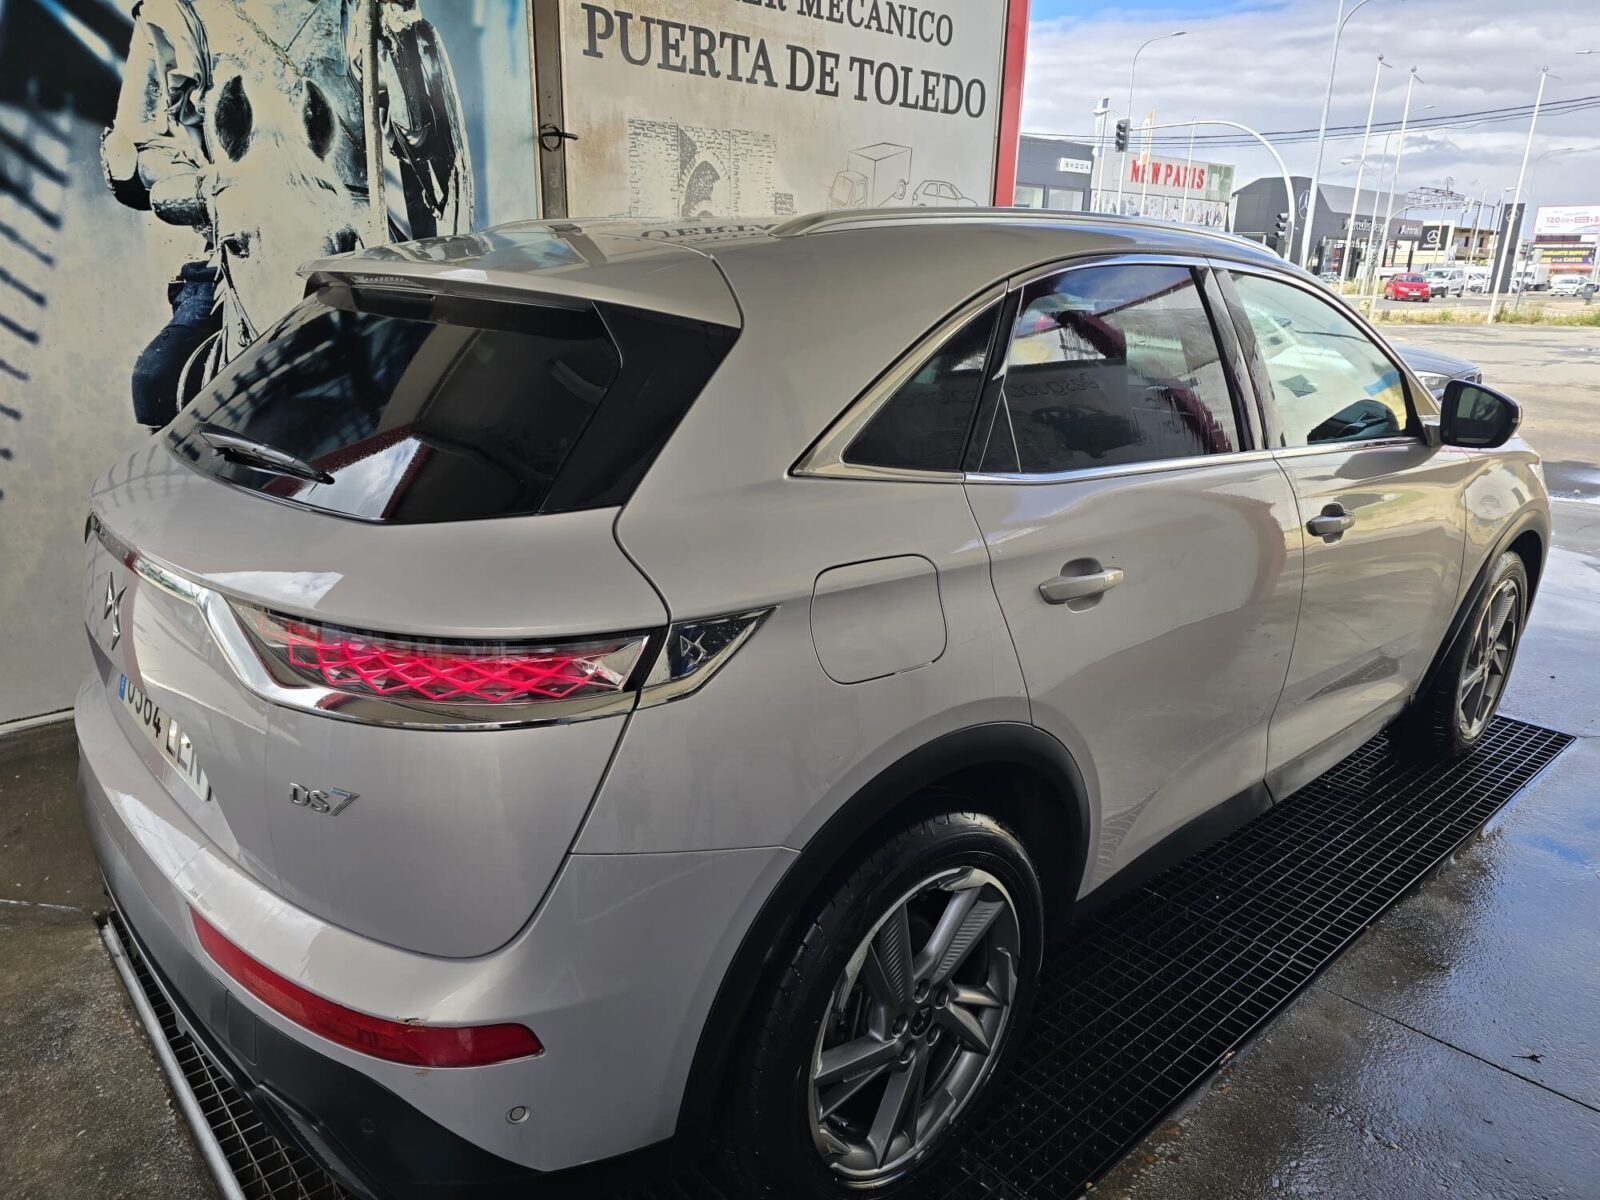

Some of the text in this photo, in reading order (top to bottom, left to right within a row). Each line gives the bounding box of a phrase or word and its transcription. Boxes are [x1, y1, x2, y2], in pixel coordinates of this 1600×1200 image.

[581, 3, 986, 118] PUERTA DE TOLEDO
